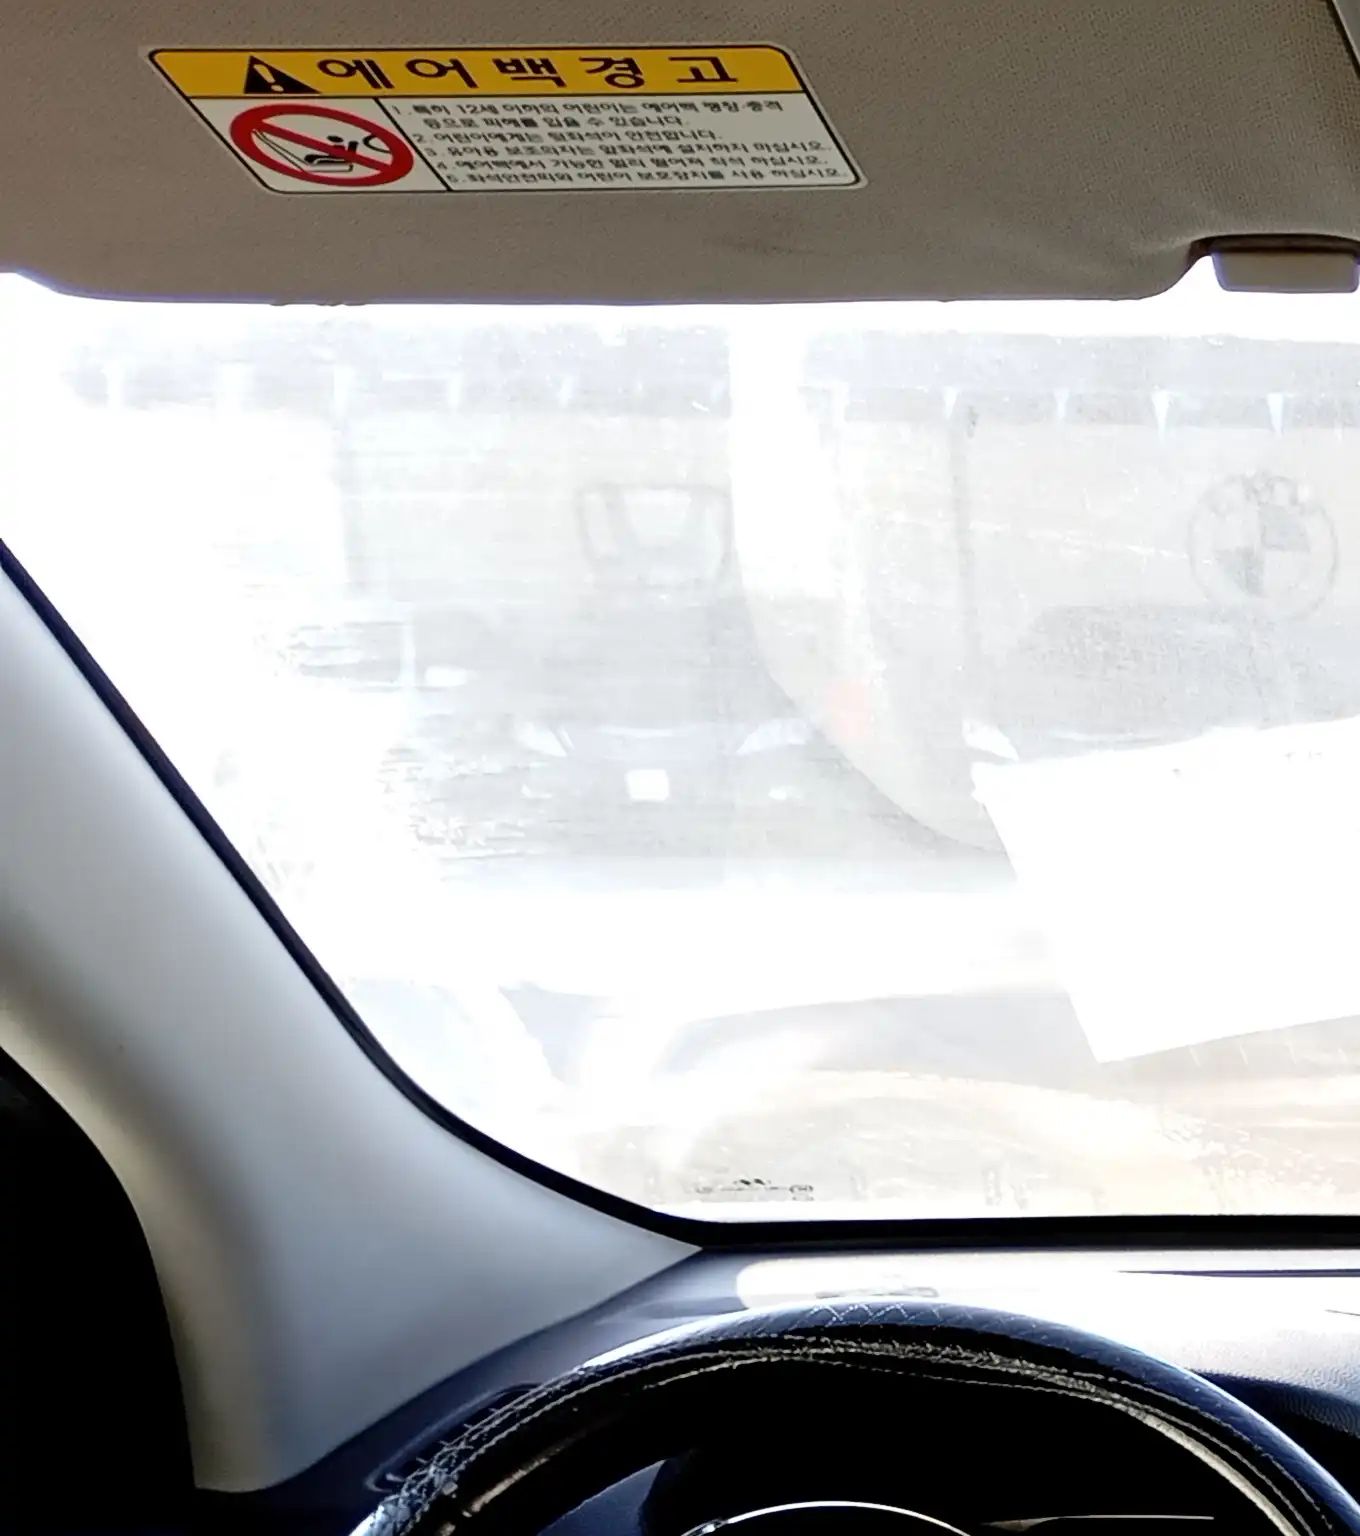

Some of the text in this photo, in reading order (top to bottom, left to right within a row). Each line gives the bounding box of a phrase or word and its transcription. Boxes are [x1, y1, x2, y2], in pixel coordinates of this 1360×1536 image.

[502, 103, 560, 115] 이하의
[562, 102, 638, 115] 어린이는
[641, 101, 700, 114] 에어백
[434, 132, 544, 145] 어린이에게는
[454, 158, 546, 171] 에어백에서
[576, 171, 633, 183] 어린이
